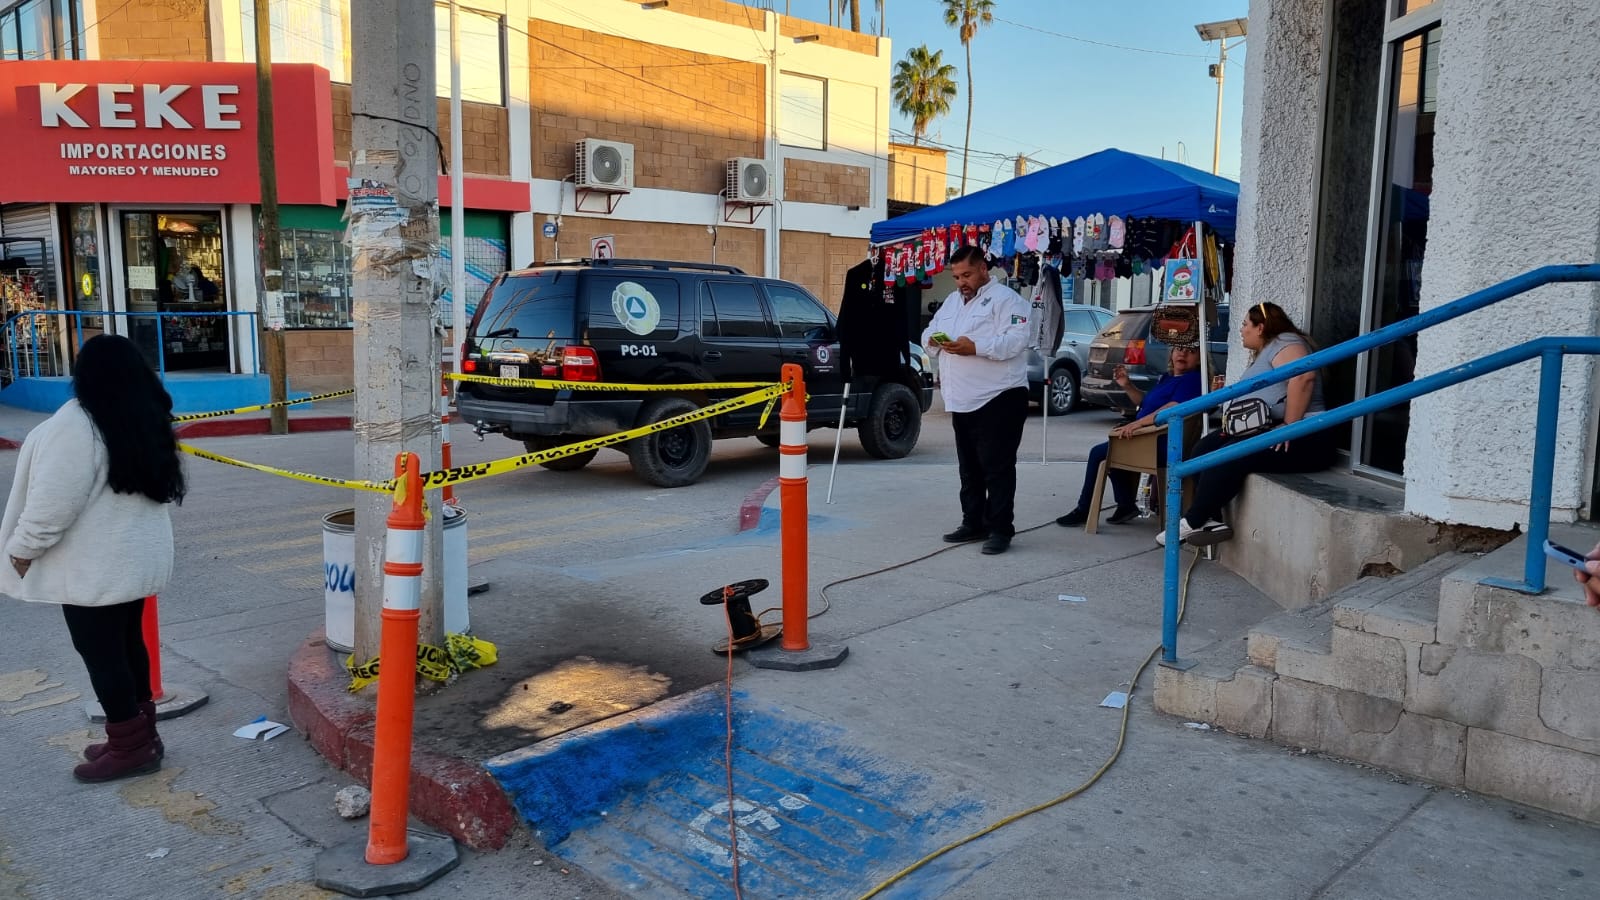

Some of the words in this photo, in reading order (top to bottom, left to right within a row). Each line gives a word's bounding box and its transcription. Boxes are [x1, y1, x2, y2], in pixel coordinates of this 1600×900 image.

[39, 82, 241, 129] KEKE
[60, 143, 226, 160] IMPORTACIONES
[69, 165, 135, 176] MAYOREO
[139, 166, 148, 176] Y
[152, 166, 219, 177] MENUDEO
[620, 344, 658, 357] PC-01
